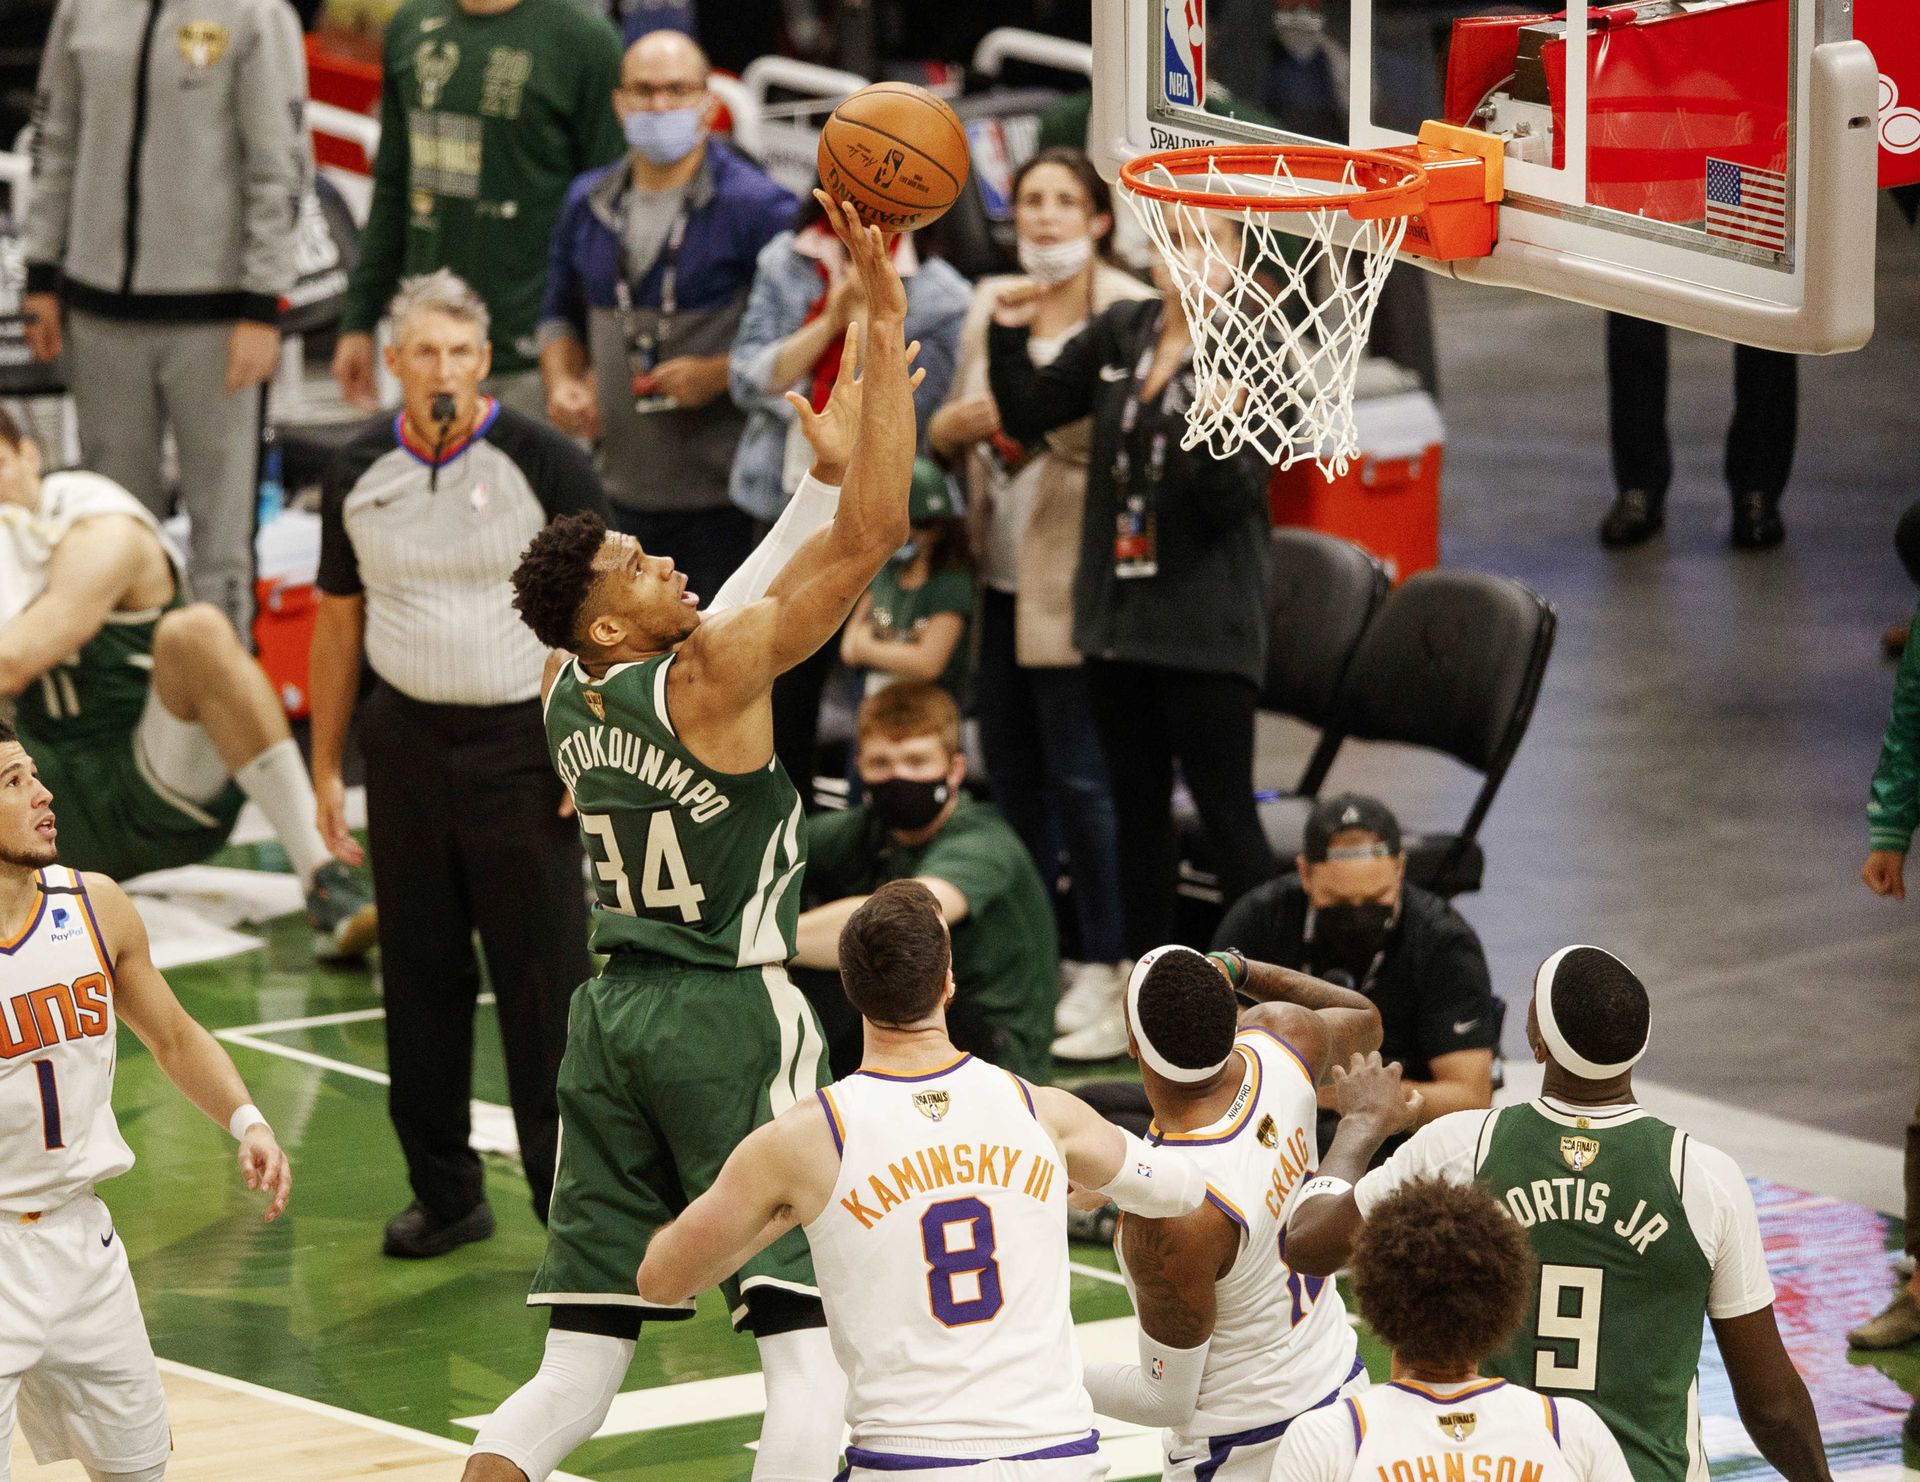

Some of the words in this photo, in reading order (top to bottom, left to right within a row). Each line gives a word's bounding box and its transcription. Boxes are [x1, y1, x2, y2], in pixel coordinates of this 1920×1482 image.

[1168, 71, 1189, 99] NBA
[557, 724, 730, 824] ETOKOUNMPO
[580, 809, 706, 924] 34
[50, 926, 85, 943] PayPal
[31, 1058, 67, 1152] 1
[927, 1091, 949, 1104] FINALS
[1227, 1100, 1244, 1121] NIKE
[1238, 1083, 1252, 1103] PRO
[840, 1143, 1023, 1231] KAMINSKY
[1023, 1154, 1055, 1203] III
[1264, 1126, 1311, 1220] CRAIG
[1576, 1140, 1598, 1153] FINALS
[1498, 1177, 1611, 1229] ORTIS
[1613, 1199, 1669, 1256] JR
[918, 1195, 1005, 1329] 8
[1535, 1263, 1604, 1392] 9
